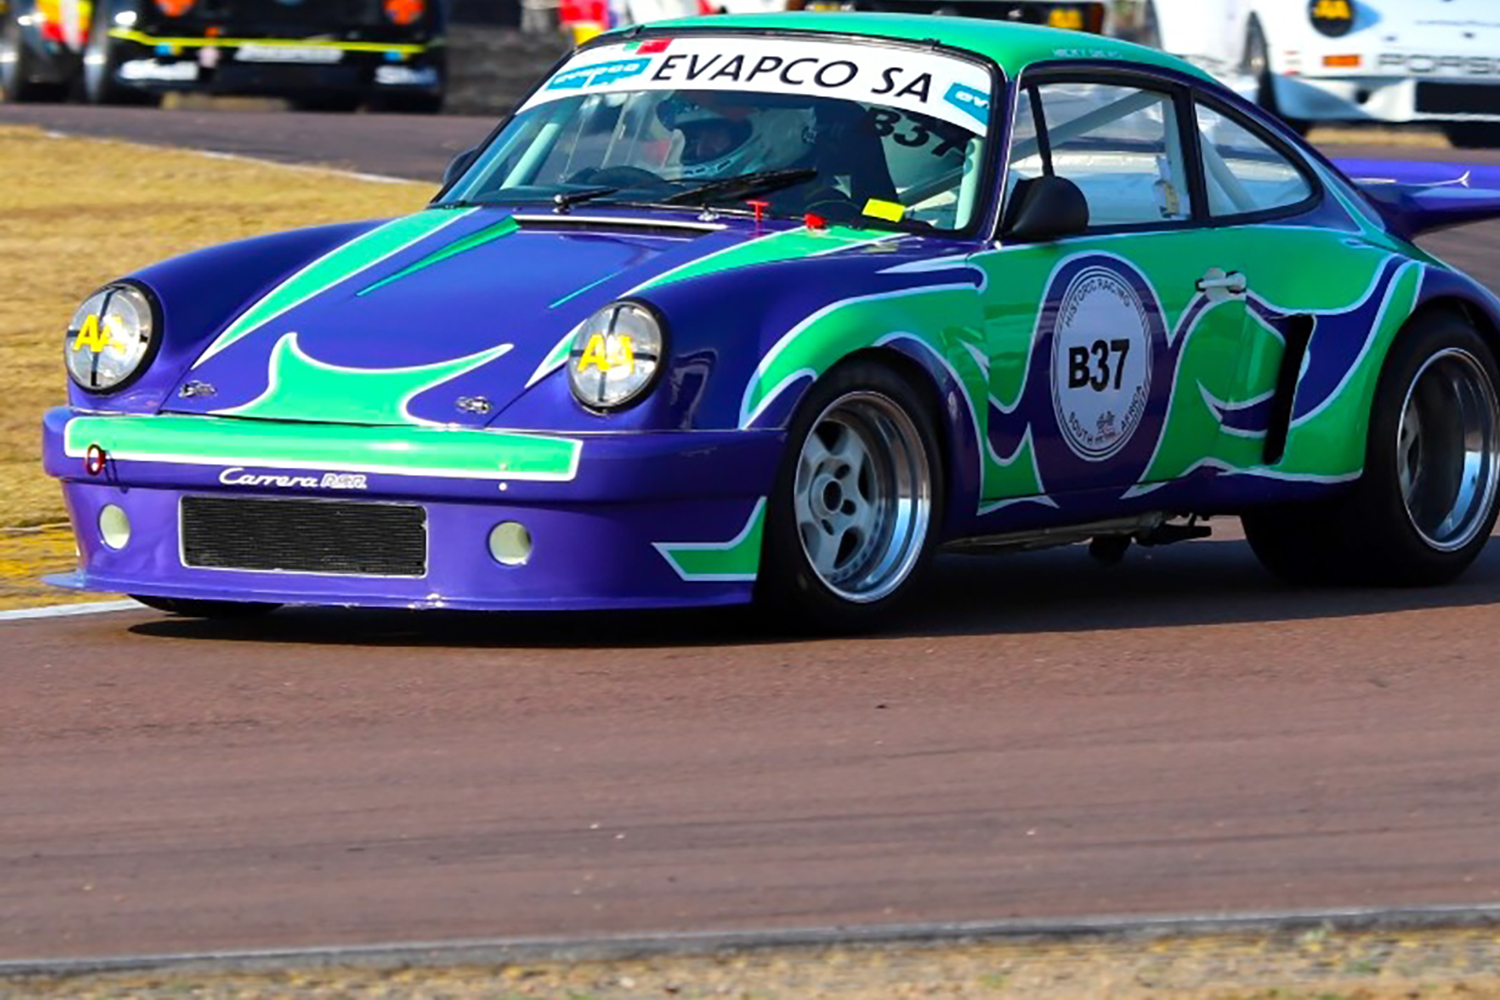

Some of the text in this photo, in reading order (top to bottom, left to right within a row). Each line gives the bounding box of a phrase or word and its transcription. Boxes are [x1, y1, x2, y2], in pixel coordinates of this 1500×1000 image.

[651, 54, 859, 88] EVAPCO
[871, 67, 932, 103] SA
[1065, 278, 1131, 328] HISTORIC RACING
[1068, 338, 1130, 392] B37
[1068, 385, 1143, 445] SOUTH AFRICA
[218, 466, 319, 488] Carrera
